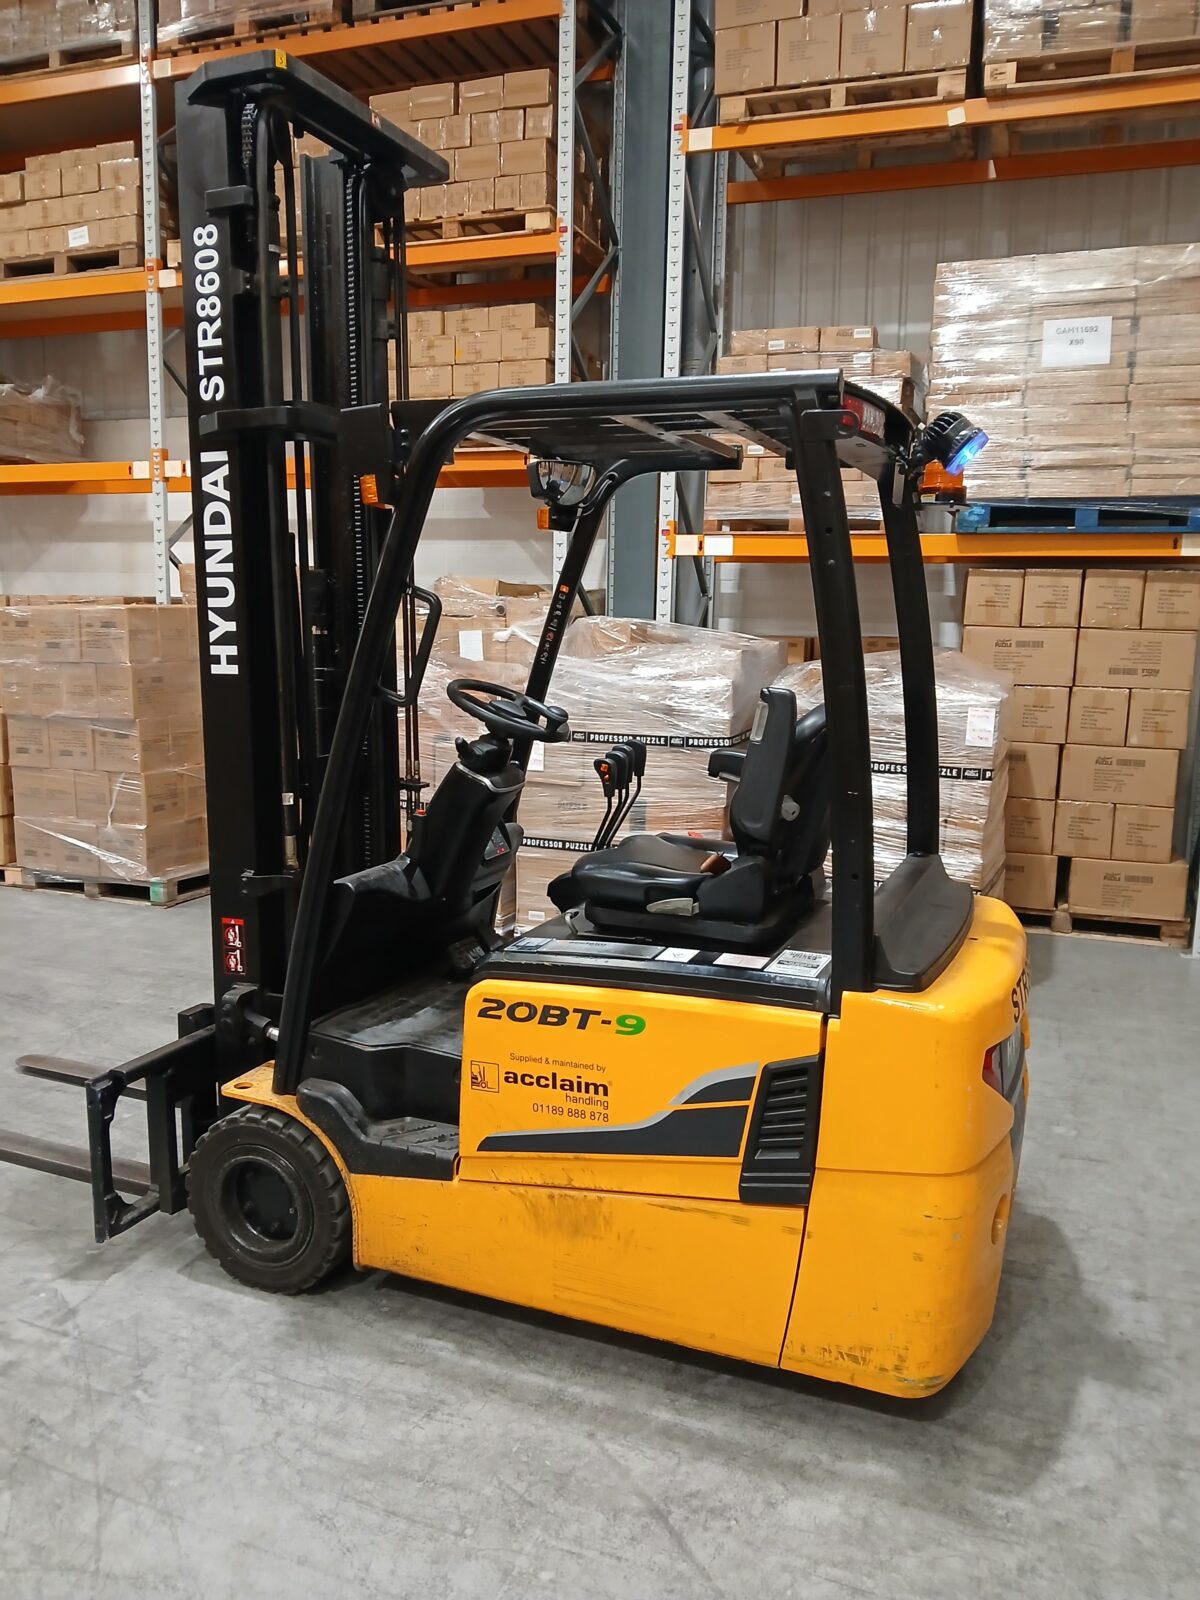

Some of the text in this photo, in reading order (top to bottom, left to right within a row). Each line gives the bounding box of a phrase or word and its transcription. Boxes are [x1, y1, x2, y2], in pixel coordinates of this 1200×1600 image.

[193, 223, 239, 675] HYUNDAI STR8608
[688, 738, 732, 747] PROFESSO
[522, 838, 563, 849] PROFESSOR
[565, 842, 593, 851] PUZZLE
[477, 997, 647, 1036] 20BT-9
[509, 1052, 606, 1074] Supplied & maintained by
[503, 1070, 609, 1097] acclaim
[565, 1092, 609, 1111] handling
[532, 1102, 609, 1123] 01189 888 878
